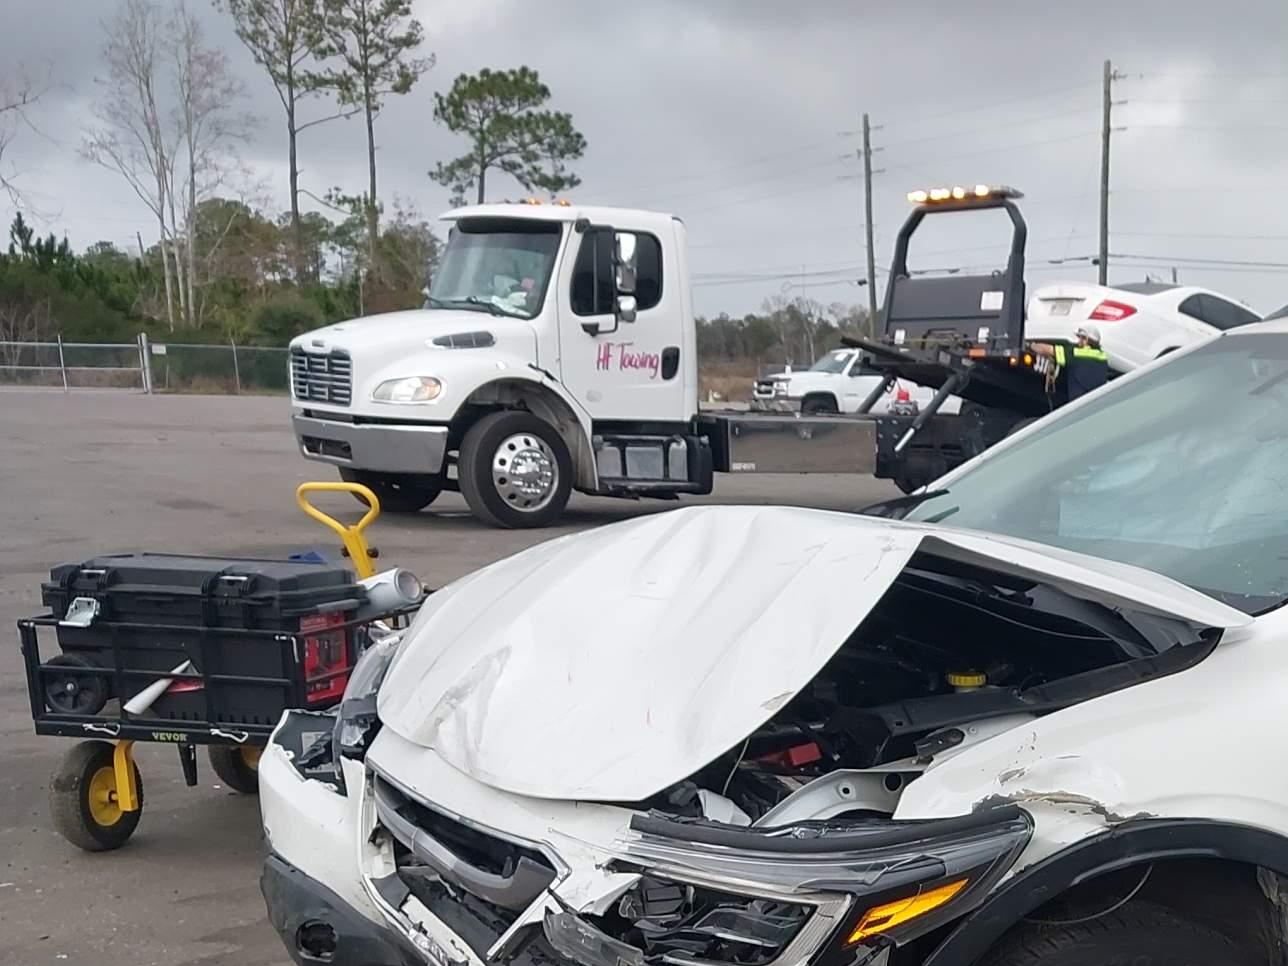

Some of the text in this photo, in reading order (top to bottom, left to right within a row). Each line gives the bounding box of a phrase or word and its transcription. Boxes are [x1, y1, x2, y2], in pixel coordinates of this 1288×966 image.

[597, 341, 659, 379] HF Towing
[152, 732, 187, 741] VEVOR
